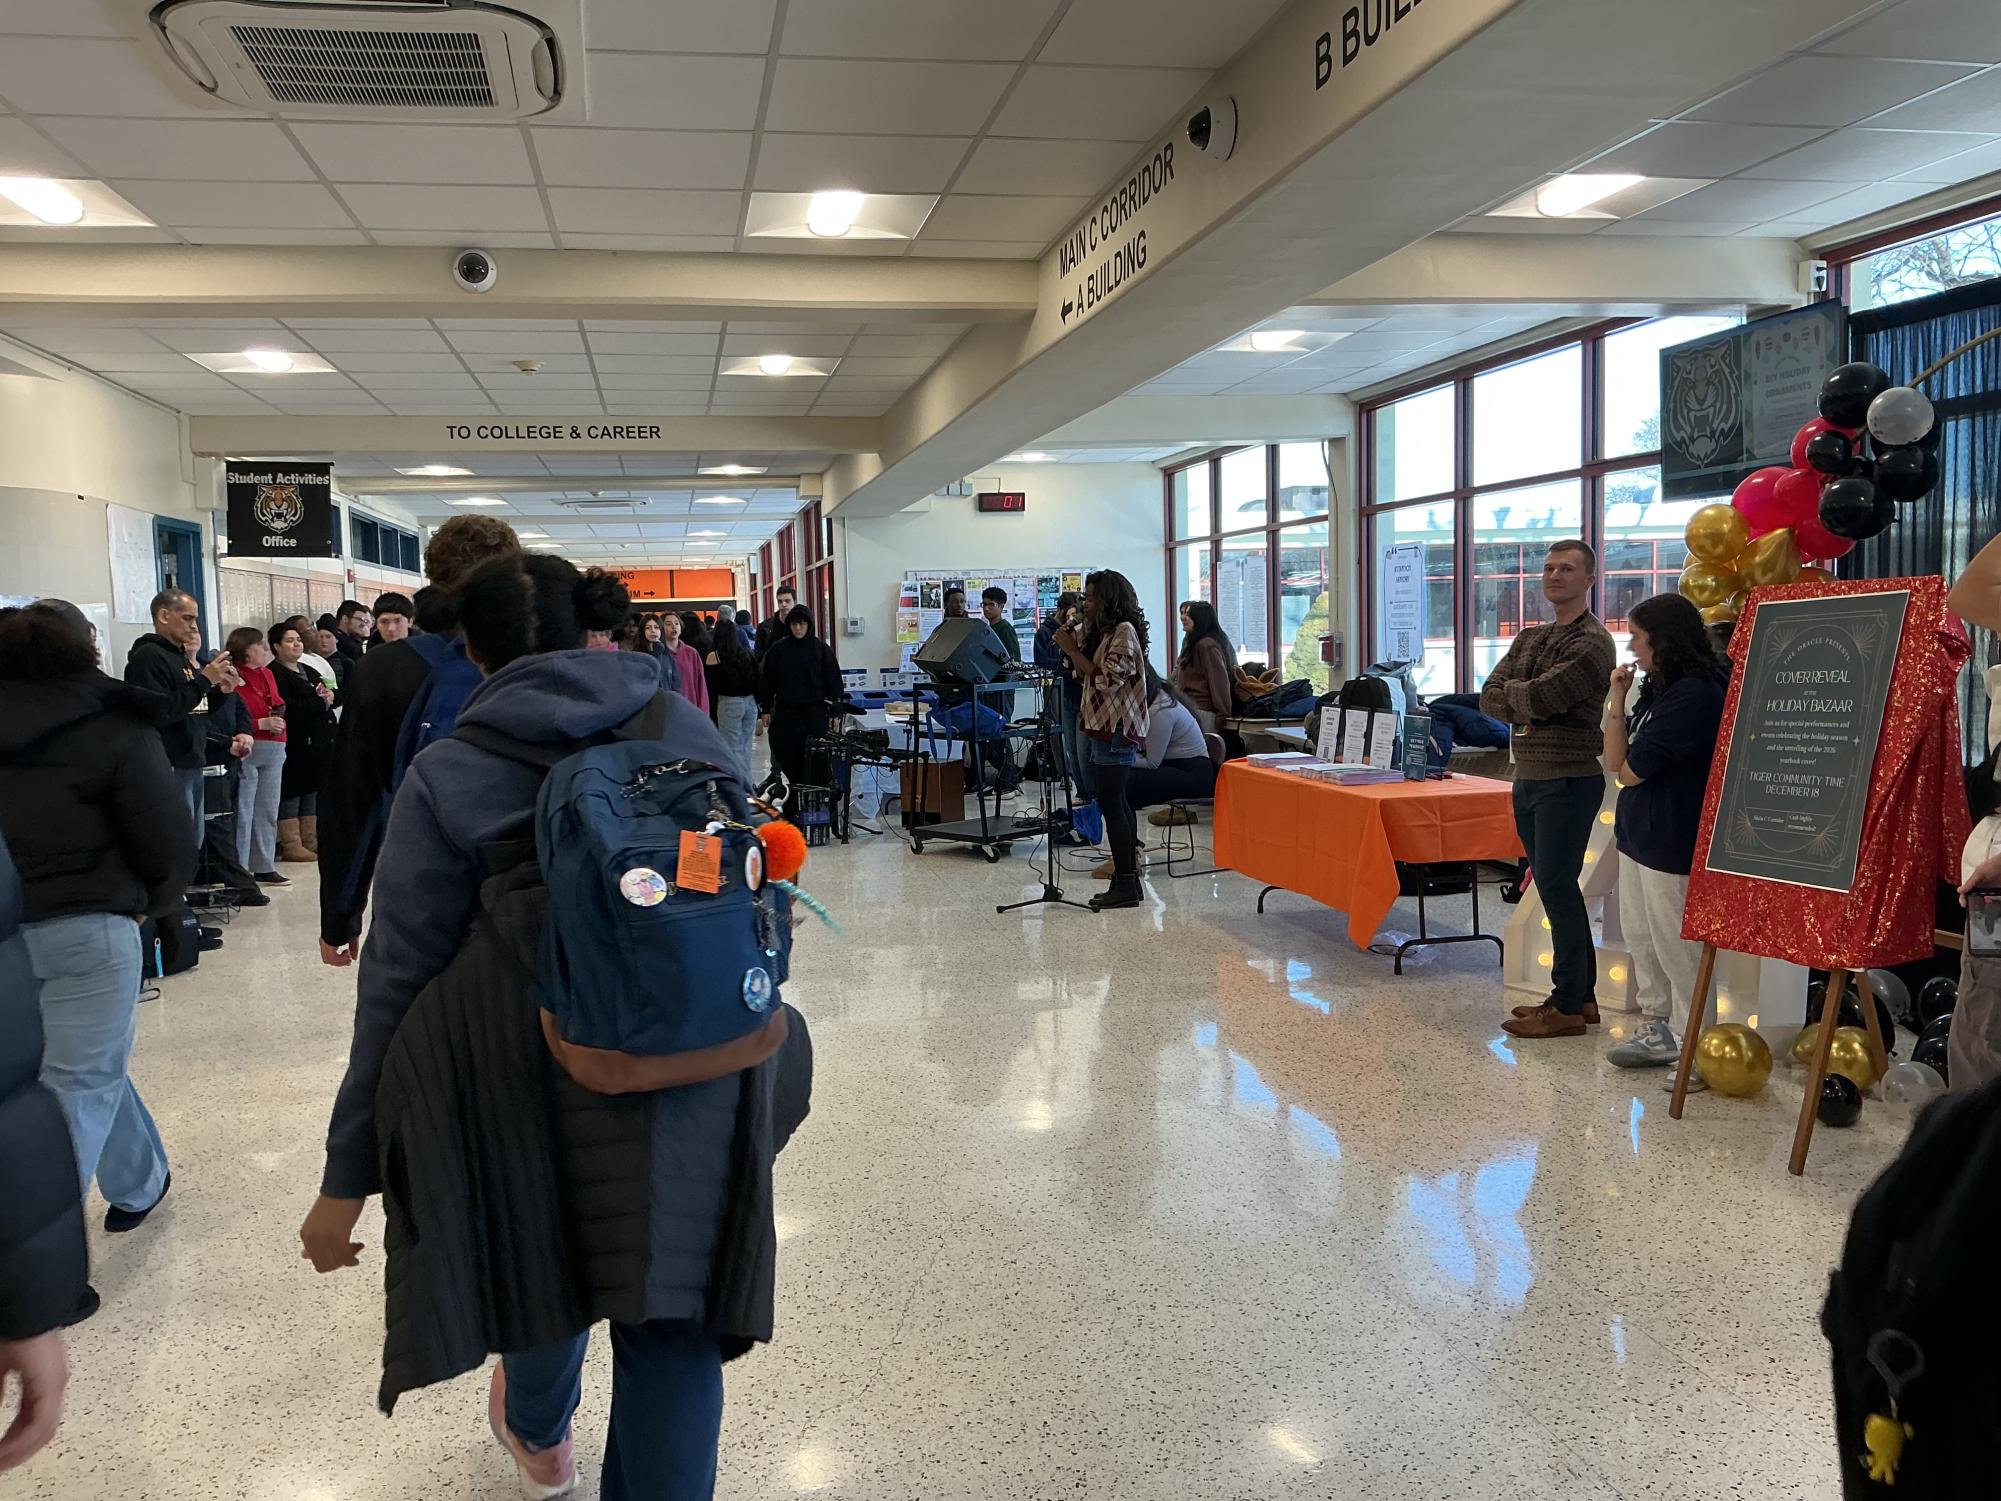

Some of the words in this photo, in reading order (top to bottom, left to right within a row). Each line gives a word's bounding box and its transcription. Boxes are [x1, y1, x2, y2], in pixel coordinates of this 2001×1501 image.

[1315, 31, 1332, 91] B
[1342, 0, 1424, 68] BUIL
[1059, 233, 1087, 280] MAIN
[1089, 216, 1098, 252] C
[1100, 142, 1175, 242] CORRIDOR
[1076, 283, 1085, 318] A
[1087, 230, 1147, 310] BUILDING
[1780, 366, 1811, 379] HOLIDAY
[446, 425, 471, 440] TO
[477, 425, 564, 440] COLLEGE
[569, 425, 582, 440] &
[587, 425, 662, 440] CAREER
[227, 472, 273, 484] Student
[276, 473, 330, 485] Activities
[262, 535, 298, 547] Office
[1775, 671, 1811, 684] COVER
[1812, 670, 1852, 684] REVEAL
[1766, 699, 1810, 712] HOLIDAY
[1810, 699, 1854, 713] BAZAAR
[1750, 771, 1772, 782] TIGER
[1773, 773, 1823, 785] COMMUNITY
[1825, 776, 1846, 788] TIME
[1765, 784, 1810, 797] DECEMBER
[1811, 788, 1820, 798] 18
